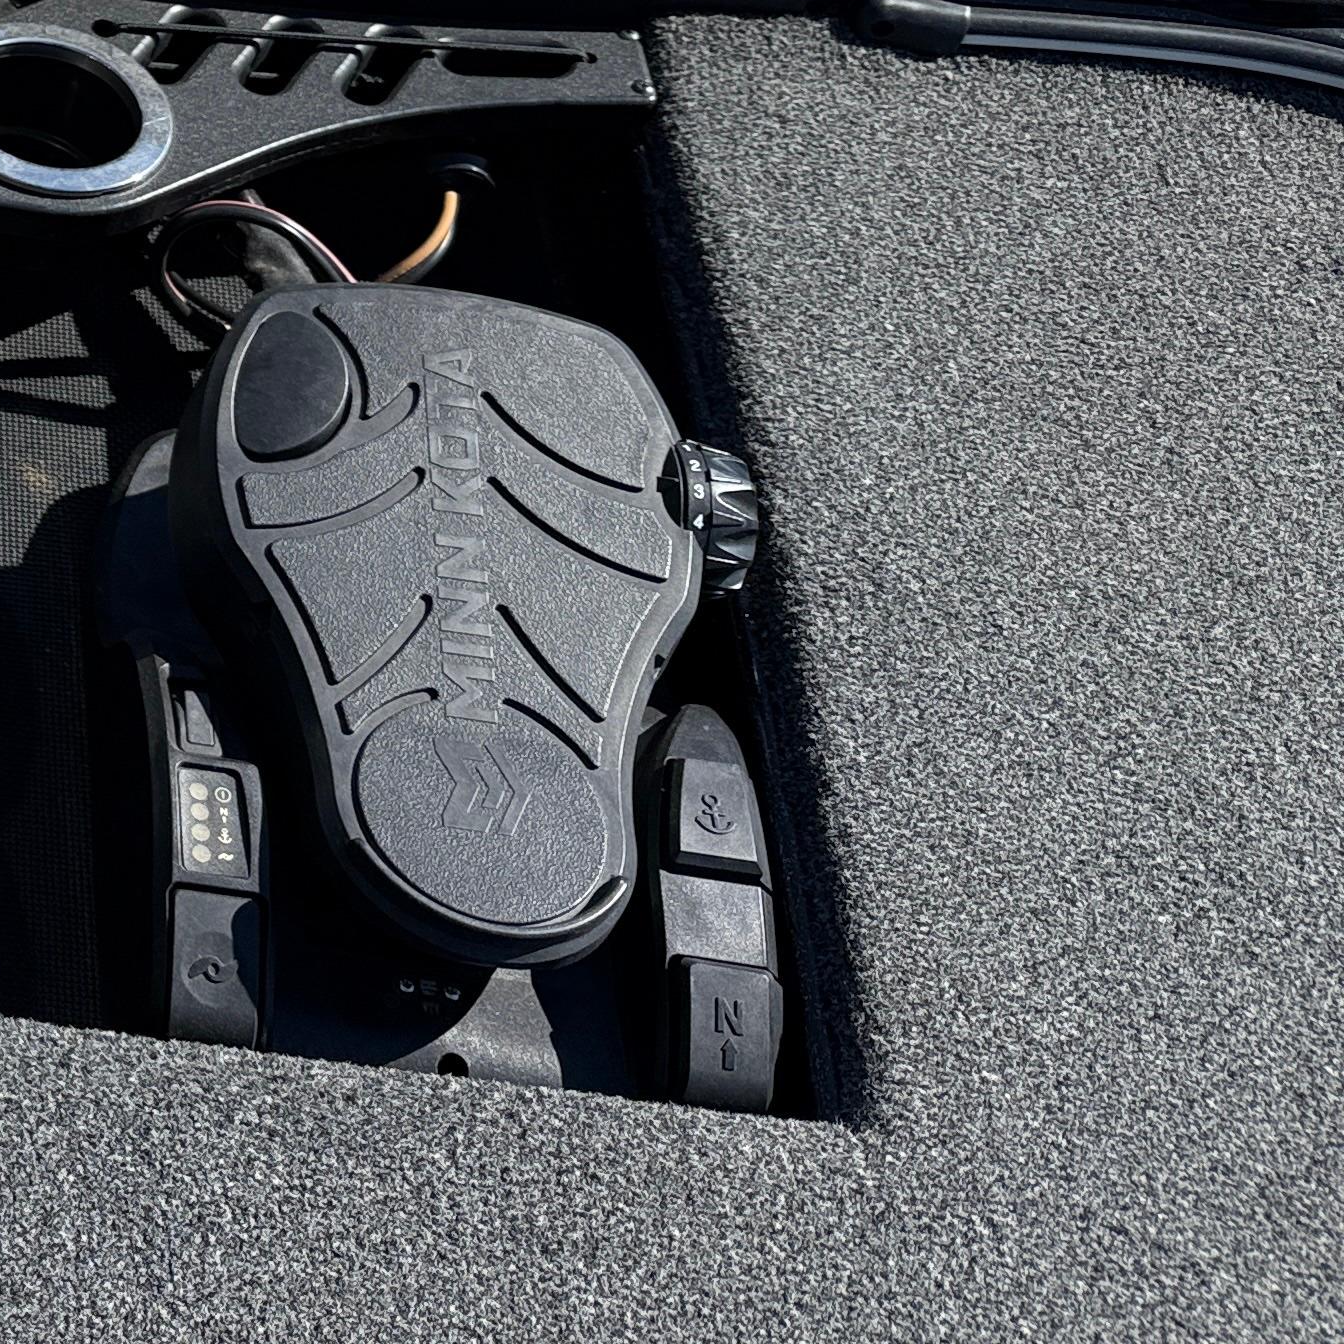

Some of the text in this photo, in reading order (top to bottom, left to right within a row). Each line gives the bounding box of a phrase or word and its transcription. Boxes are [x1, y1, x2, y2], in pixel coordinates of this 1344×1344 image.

[688, 459, 703, 473] 2
[693, 483, 706, 500] 3
[693, 513, 705, 531] 4
[422, 346, 500, 725] MINN KOTA
[714, 996, 745, 1037] N
